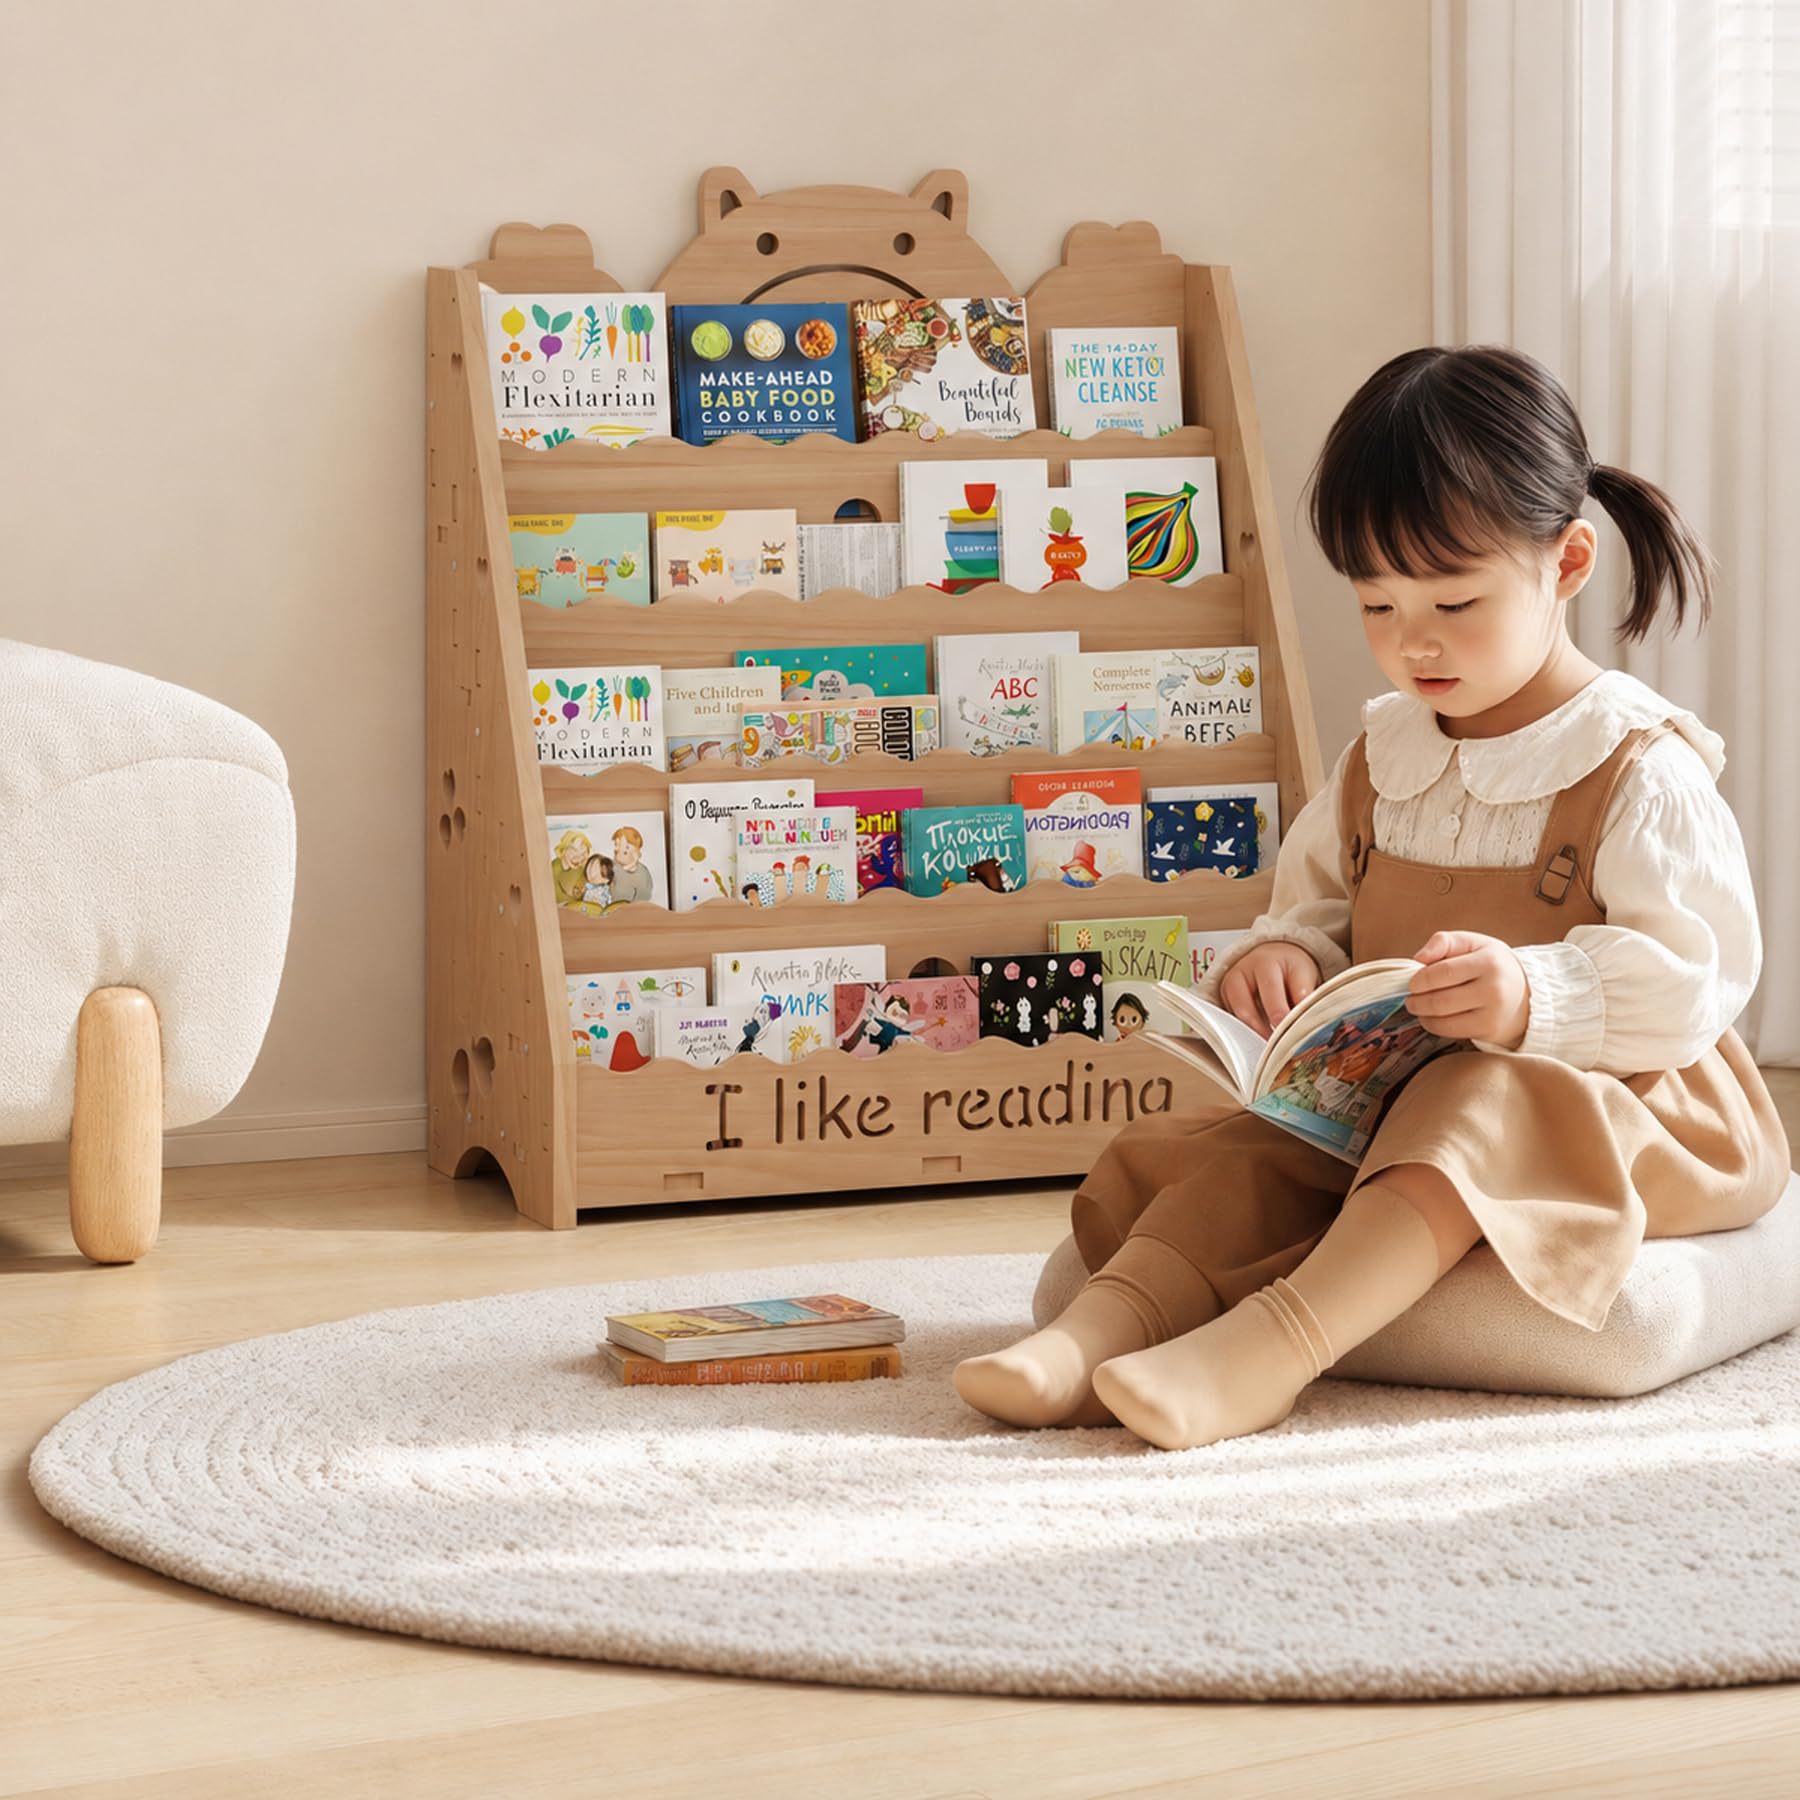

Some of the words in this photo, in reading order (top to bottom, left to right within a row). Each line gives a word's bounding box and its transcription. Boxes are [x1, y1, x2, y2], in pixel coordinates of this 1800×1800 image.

[1072, 344, 1099, 354] THE
[1107, 343, 1158, 353] 14-DAY
[501, 368, 655, 384] MODERN
[1065, 358, 1105, 378] NEW
[700, 371, 833, 386] MAKE-AHEAD
[504, 385, 655, 408] Flexitarian
[700, 390, 760, 408] BABY
[769, 389, 835, 406] FOOD
[939, 377, 1020, 406] Beautiful
[1078, 382, 1158, 403] CLEANSE
[702, 409, 836, 423] COOKBOOK
[666, 687, 697, 701] Five
[699, 686, 764, 700] Children
[990, 677, 1038, 700] ABC
[694, 702, 721, 714] and
[535, 727, 652, 741] MODERN
[537, 741, 652, 760] Flexitarian
[1118, 946, 1182, 982] SKATT
[705, 1084, 743, 1150] I
[775, 1075, 894, 1144] like
